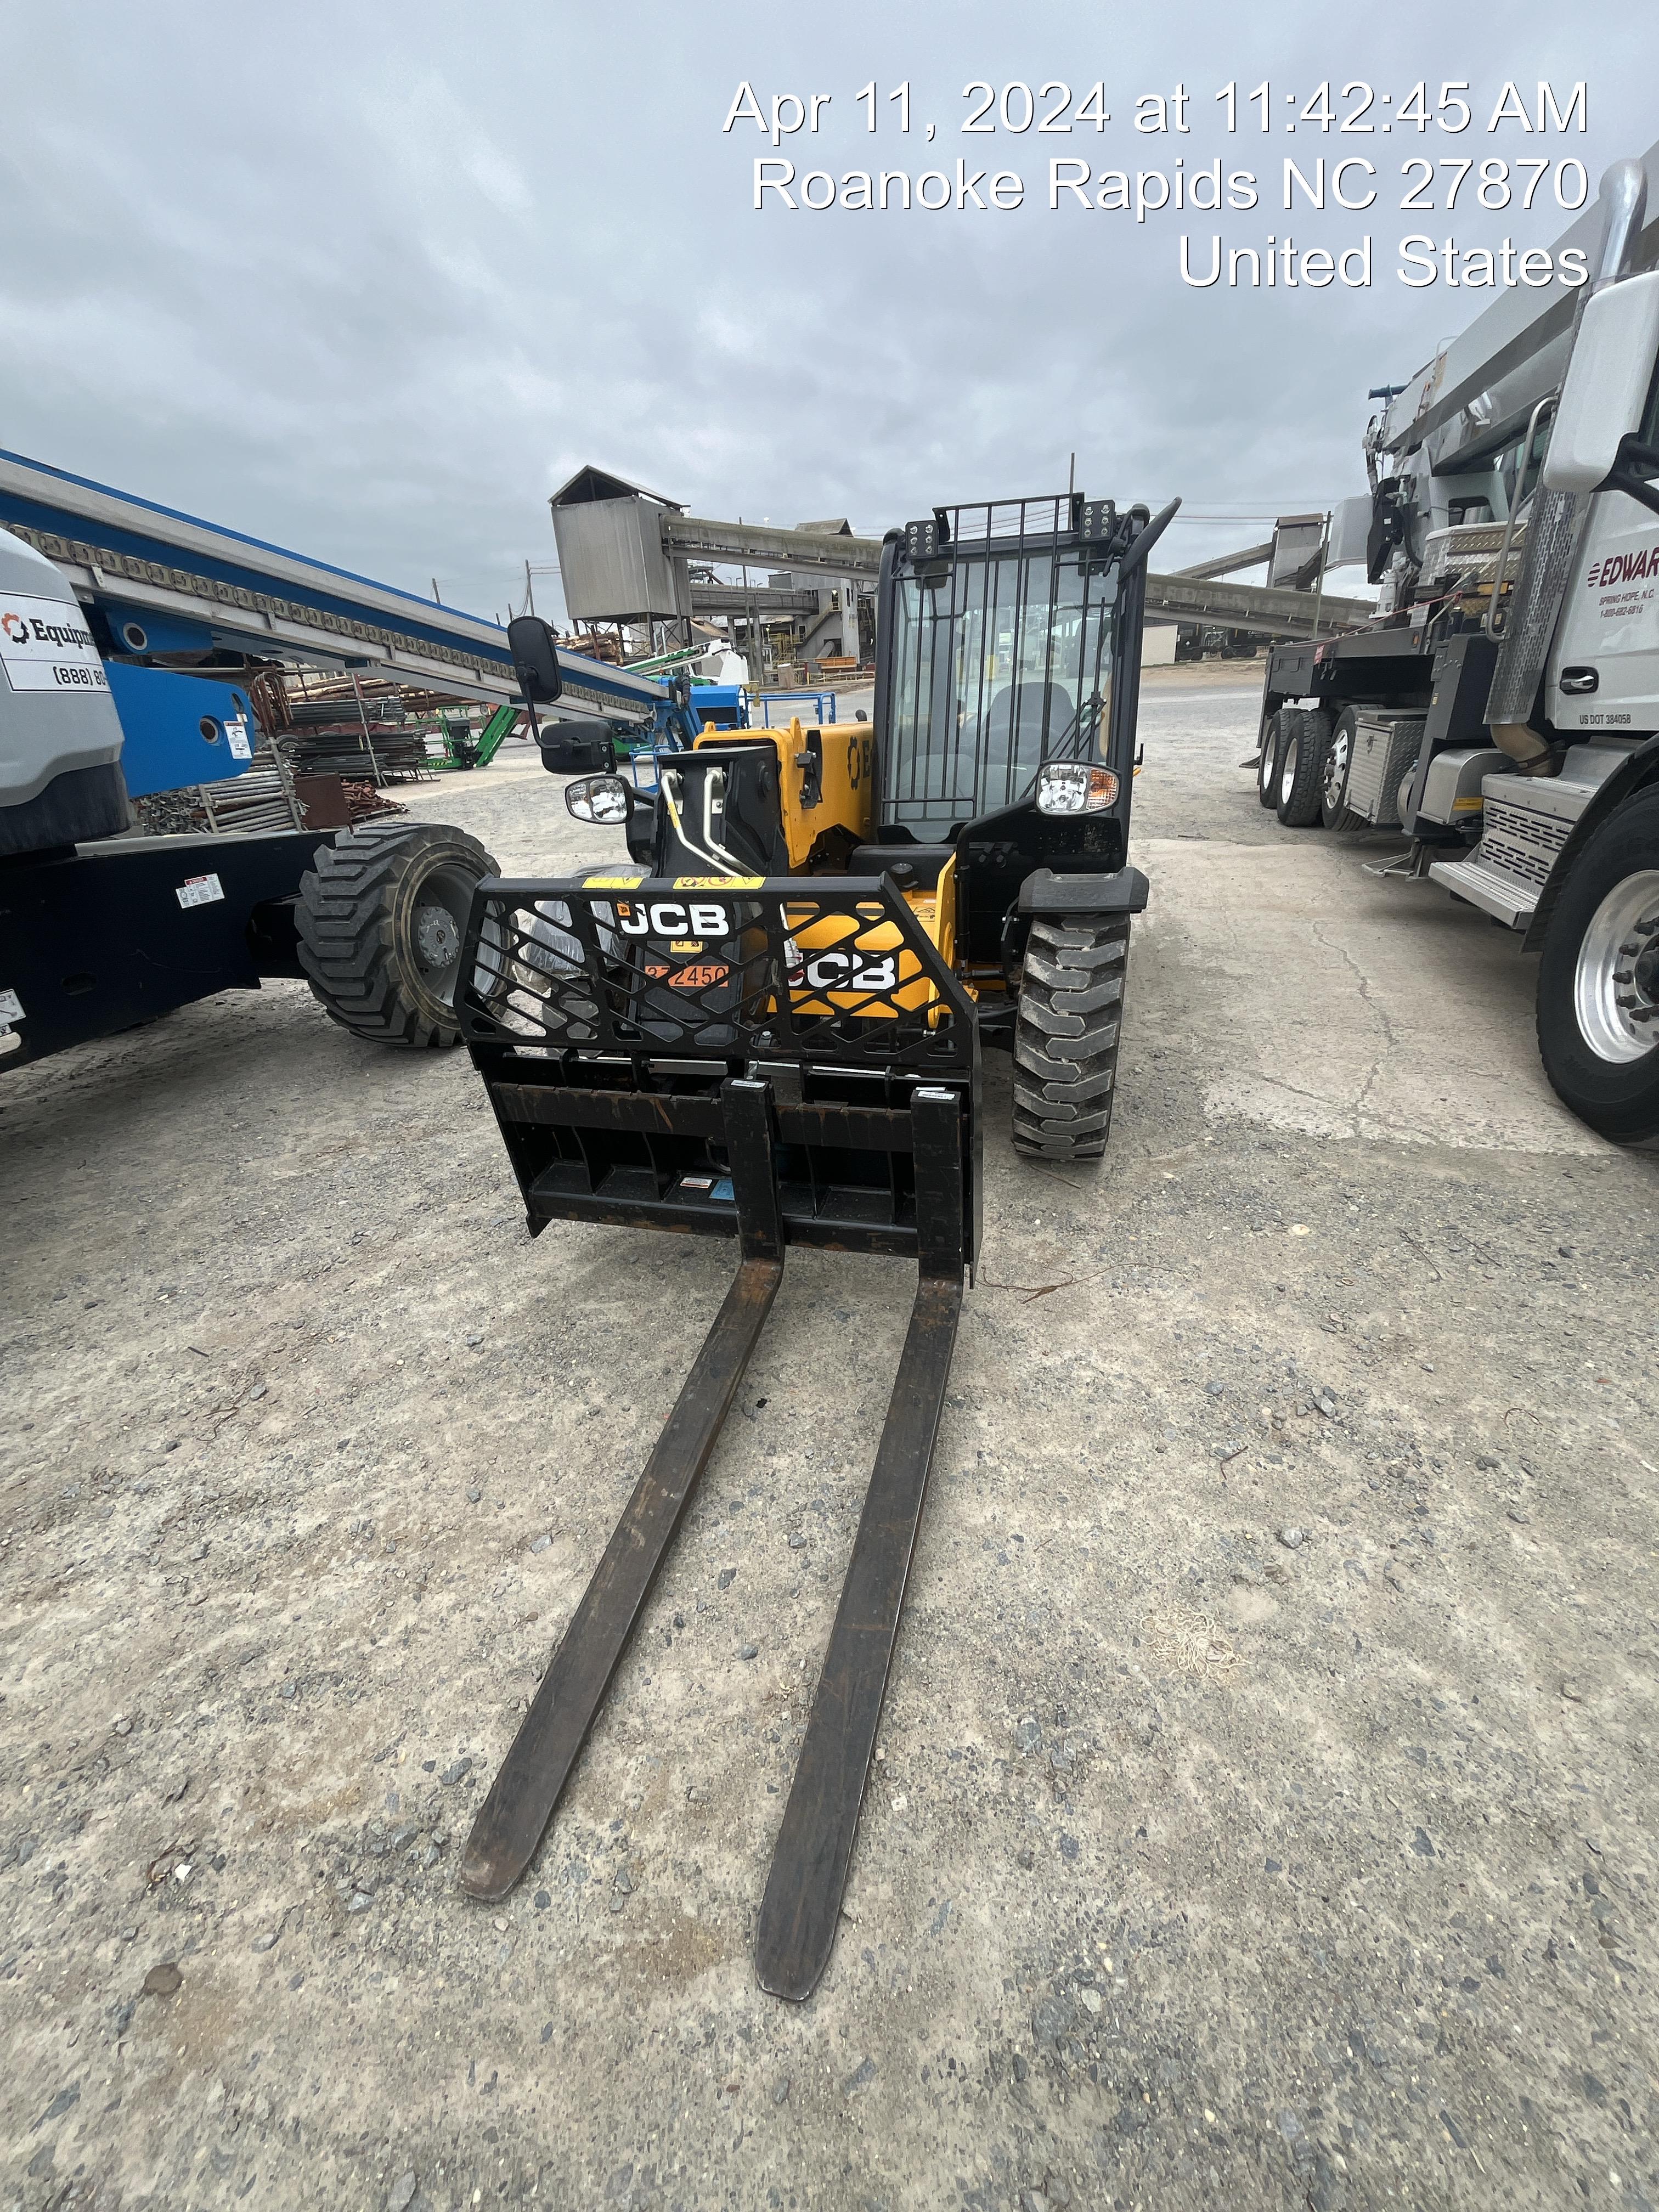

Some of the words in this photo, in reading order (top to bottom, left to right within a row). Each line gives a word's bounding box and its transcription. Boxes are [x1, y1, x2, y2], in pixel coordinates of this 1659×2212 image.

[53, 665, 93, 686] (888)
[1579, 714, 1589, 724] US
[1590, 714, 1604, 724] DOT
[620, 903, 730, 936] JCB
